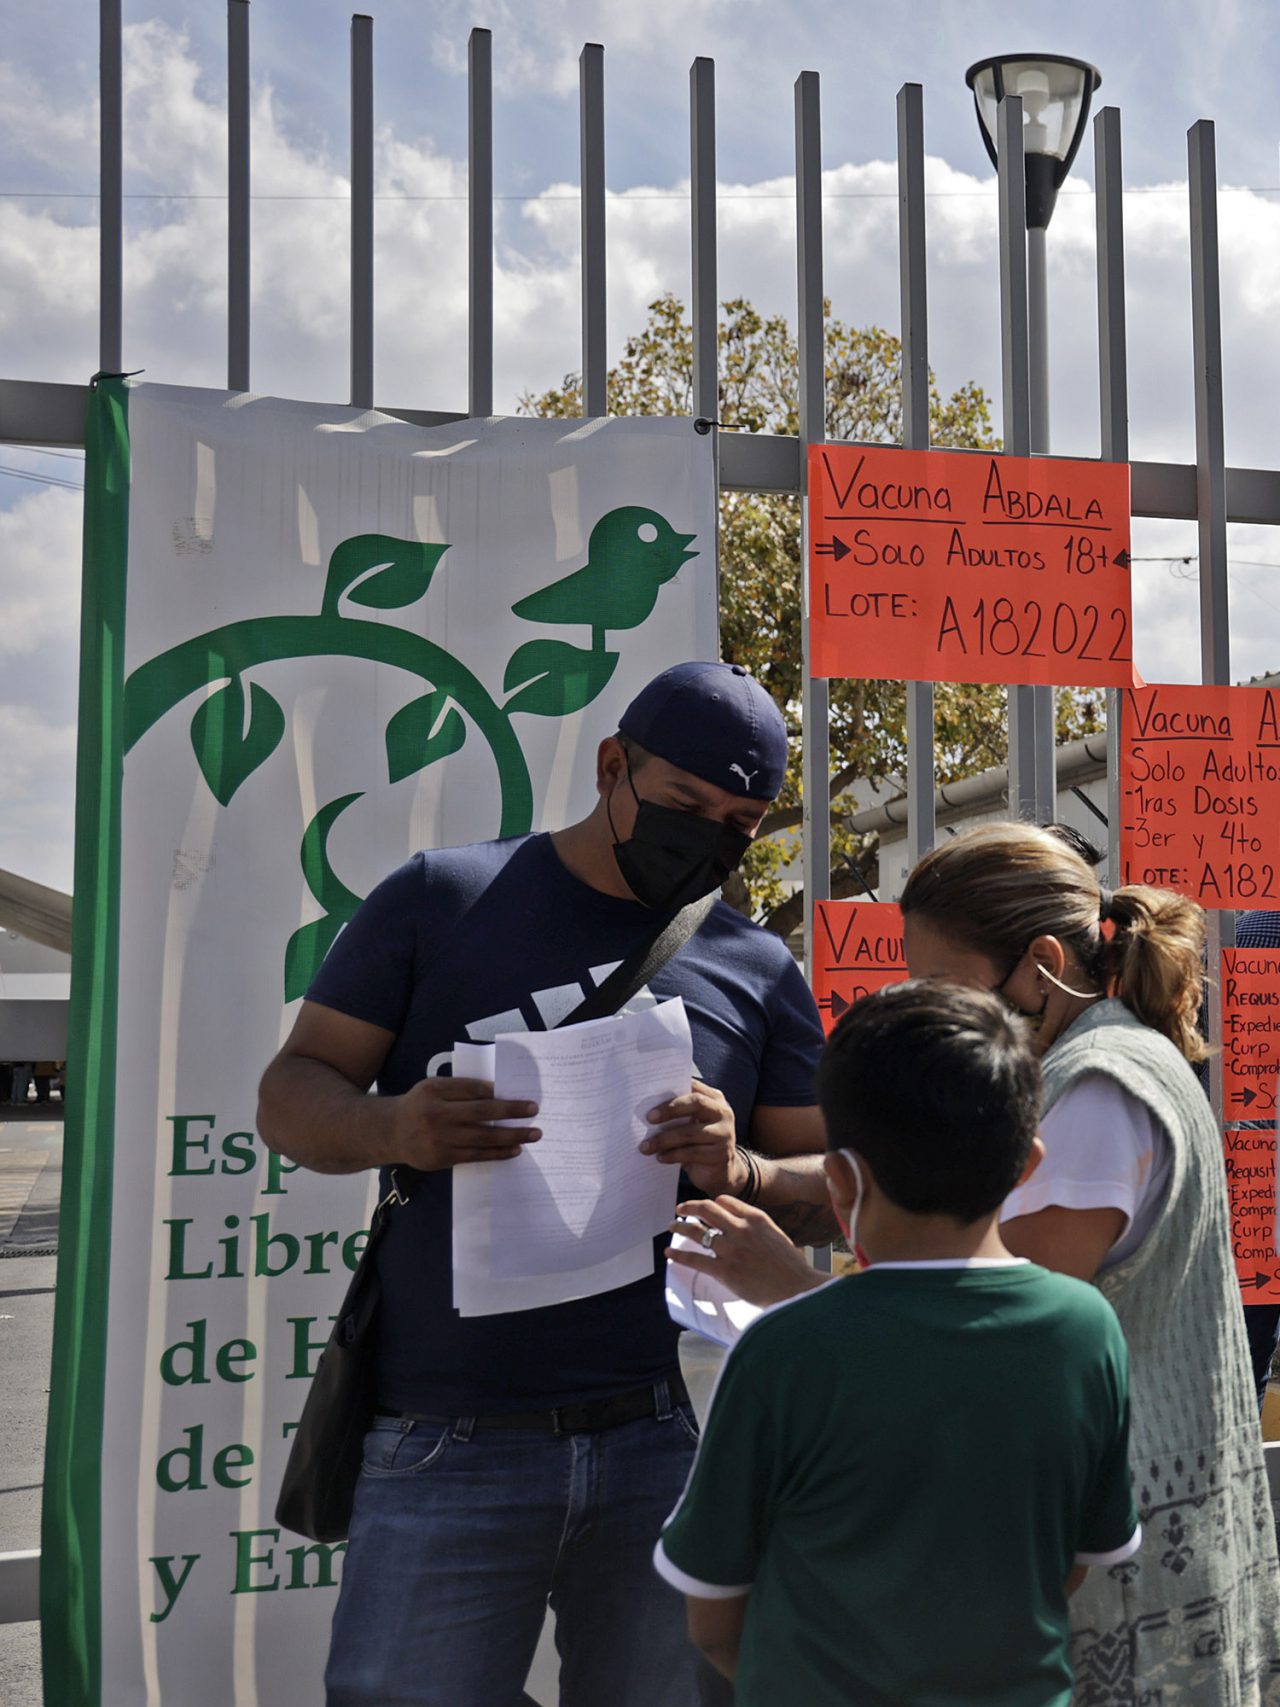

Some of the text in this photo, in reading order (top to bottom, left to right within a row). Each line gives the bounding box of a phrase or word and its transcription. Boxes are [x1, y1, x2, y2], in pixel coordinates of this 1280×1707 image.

[822, 452, 1103, 520] Vacuna ABDALA
[946, 528, 1046, 570] ADULTOS
[1064, 535, 1109, 574] 18+
[825, 583, 1132, 662] LOTE: A182022
[1128, 688, 1231, 737] Vacuna
[1131, 747, 1185, 782] Solo
[1192, 832, 1204, 859] y
[1220, 821, 1262, 854] 4to
[1225, 1158, 1276, 1184] Requisit
[159, 1318, 257, 1386] de
[156, 1424, 255, 1493] de
[149, 1553, 200, 1623] y
